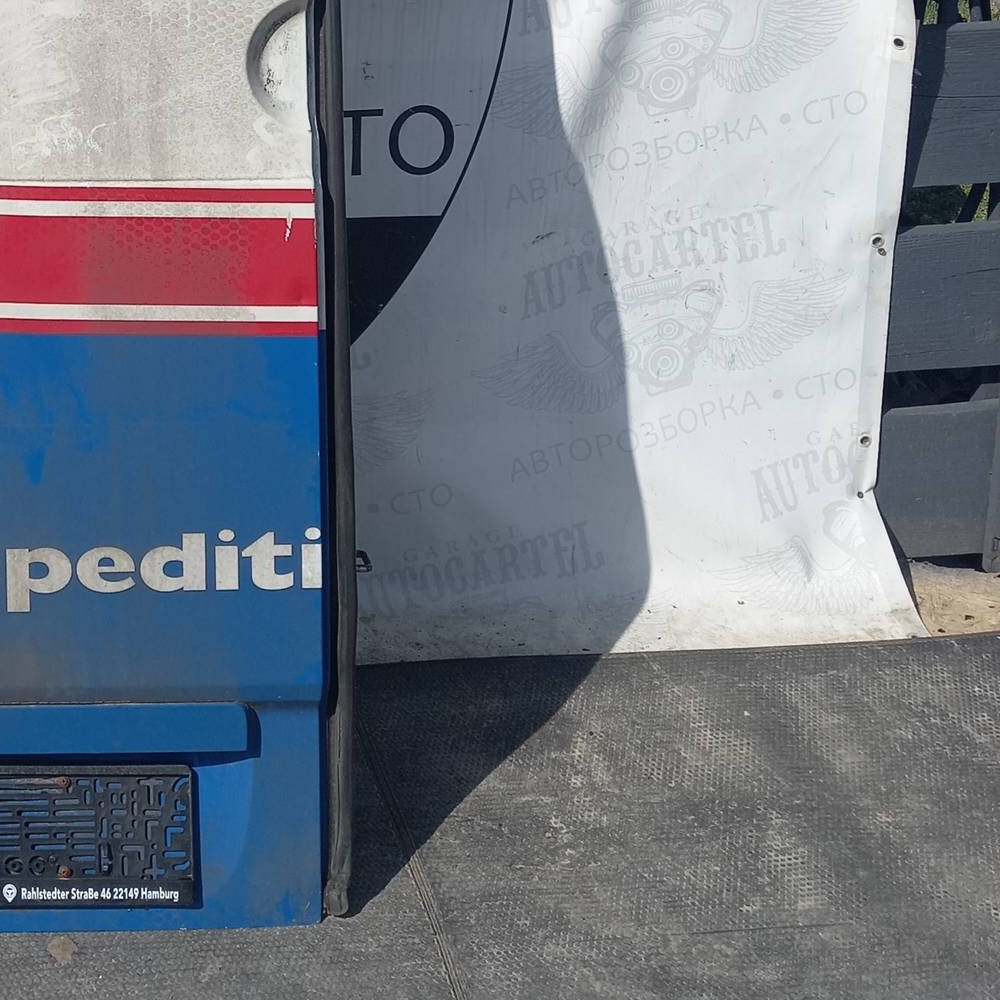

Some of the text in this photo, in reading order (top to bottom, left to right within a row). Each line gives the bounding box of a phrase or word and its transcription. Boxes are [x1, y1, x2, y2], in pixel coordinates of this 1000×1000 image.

[802, 89, 868, 126] СТО
[520, 203, 787, 321] AUTOCARTEL
[509, 367, 857, 484] АВТОРОЗБОРКА СТО
[389, 482, 453, 516] СТО
[21, 886, 69, 900] Rahlstedter
[100, 887, 111, 900] 46
[113, 887, 139, 900] 22149
[141, 886, 179, 903] Hamburg
